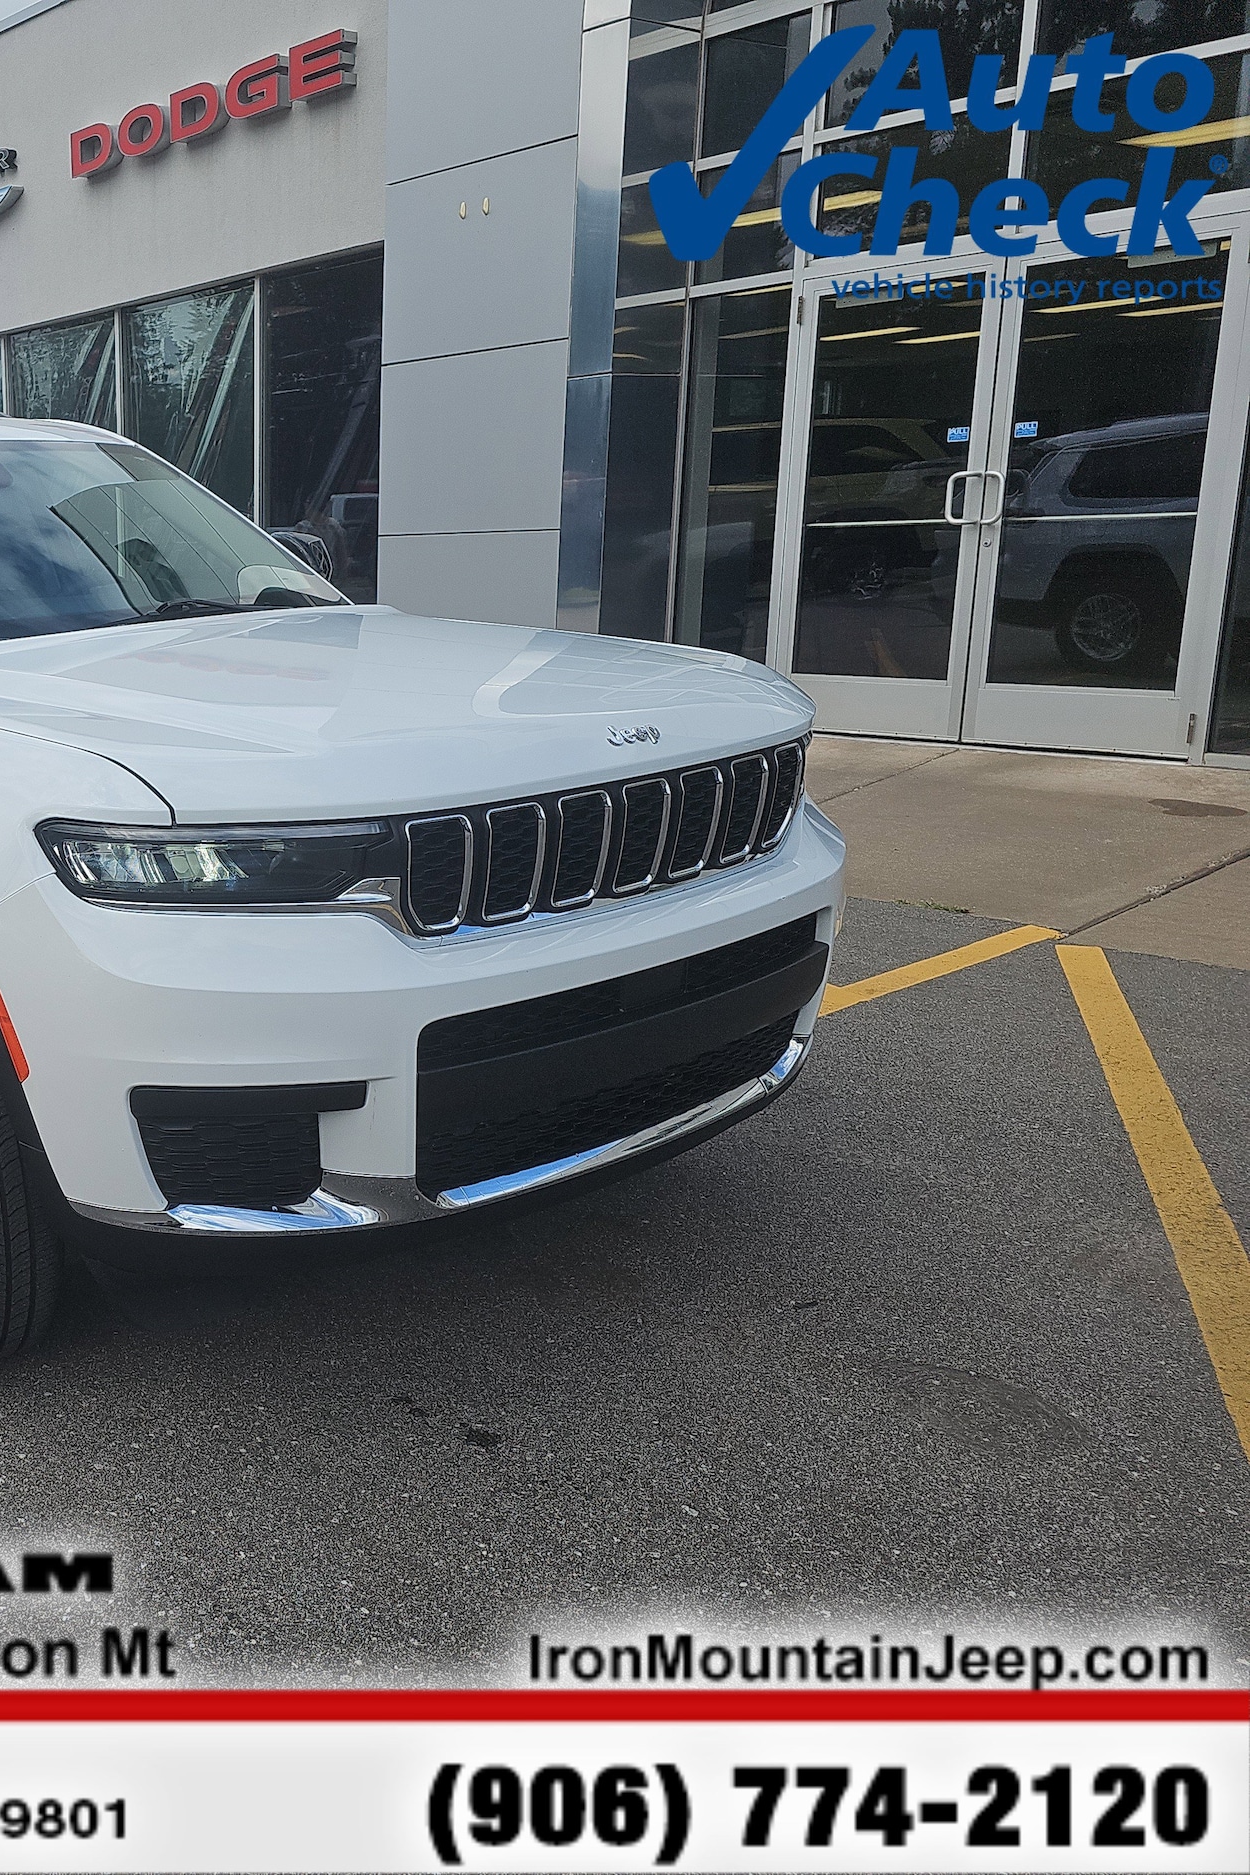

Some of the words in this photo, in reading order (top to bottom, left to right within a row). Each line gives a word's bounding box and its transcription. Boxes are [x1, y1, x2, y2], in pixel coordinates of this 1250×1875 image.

[70, 28, 358, 179] DODGE
[1016, 422, 1037, 431] PULL
[607, 723, 661, 747] Jeep
